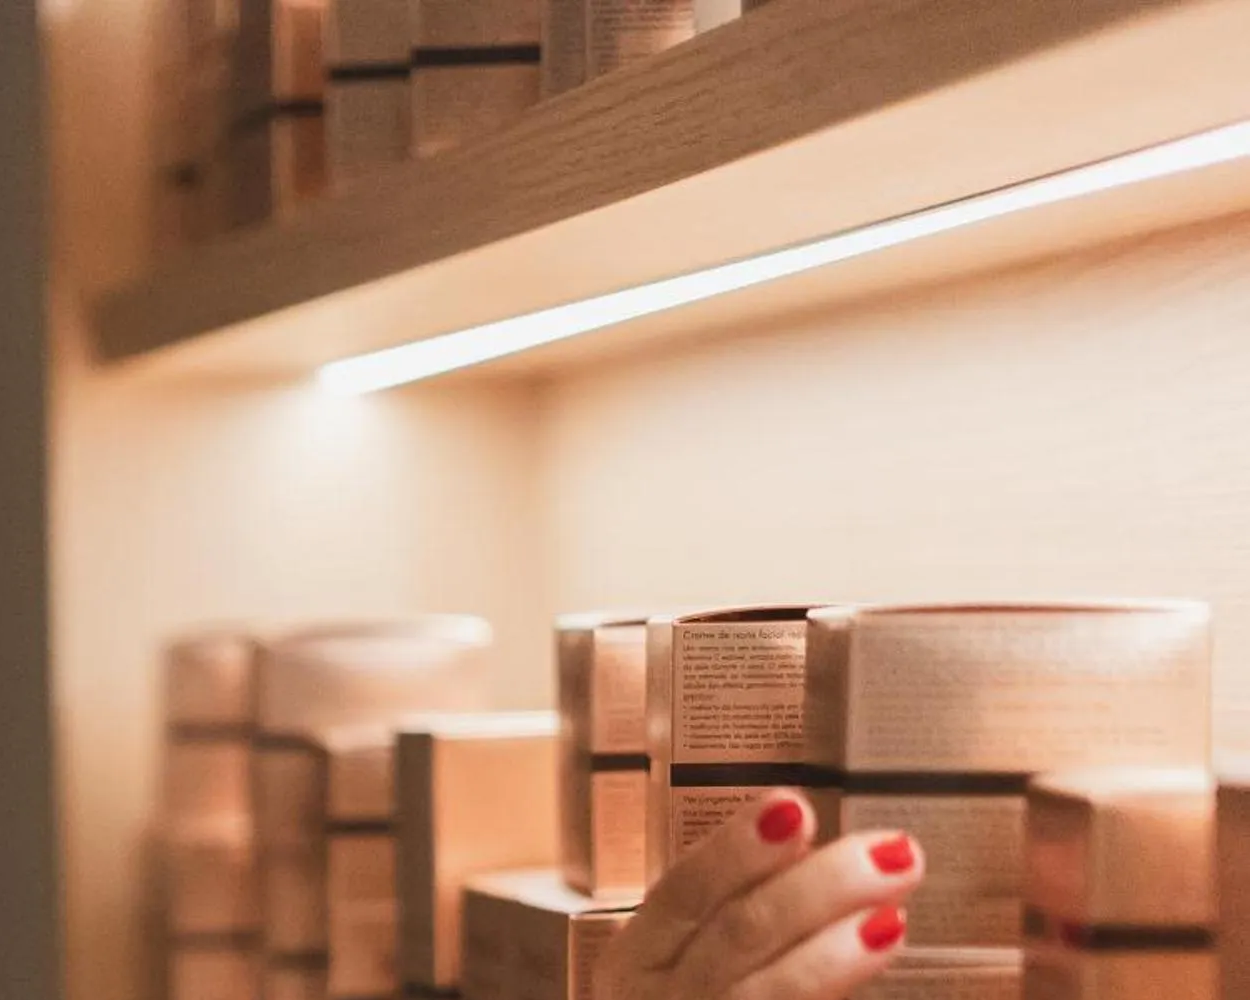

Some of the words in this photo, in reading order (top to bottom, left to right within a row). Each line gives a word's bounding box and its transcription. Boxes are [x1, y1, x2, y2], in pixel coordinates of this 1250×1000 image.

[683, 630, 715, 640] Creme
[718, 629, 730, 640] de
[758, 629, 784, 640] facial
